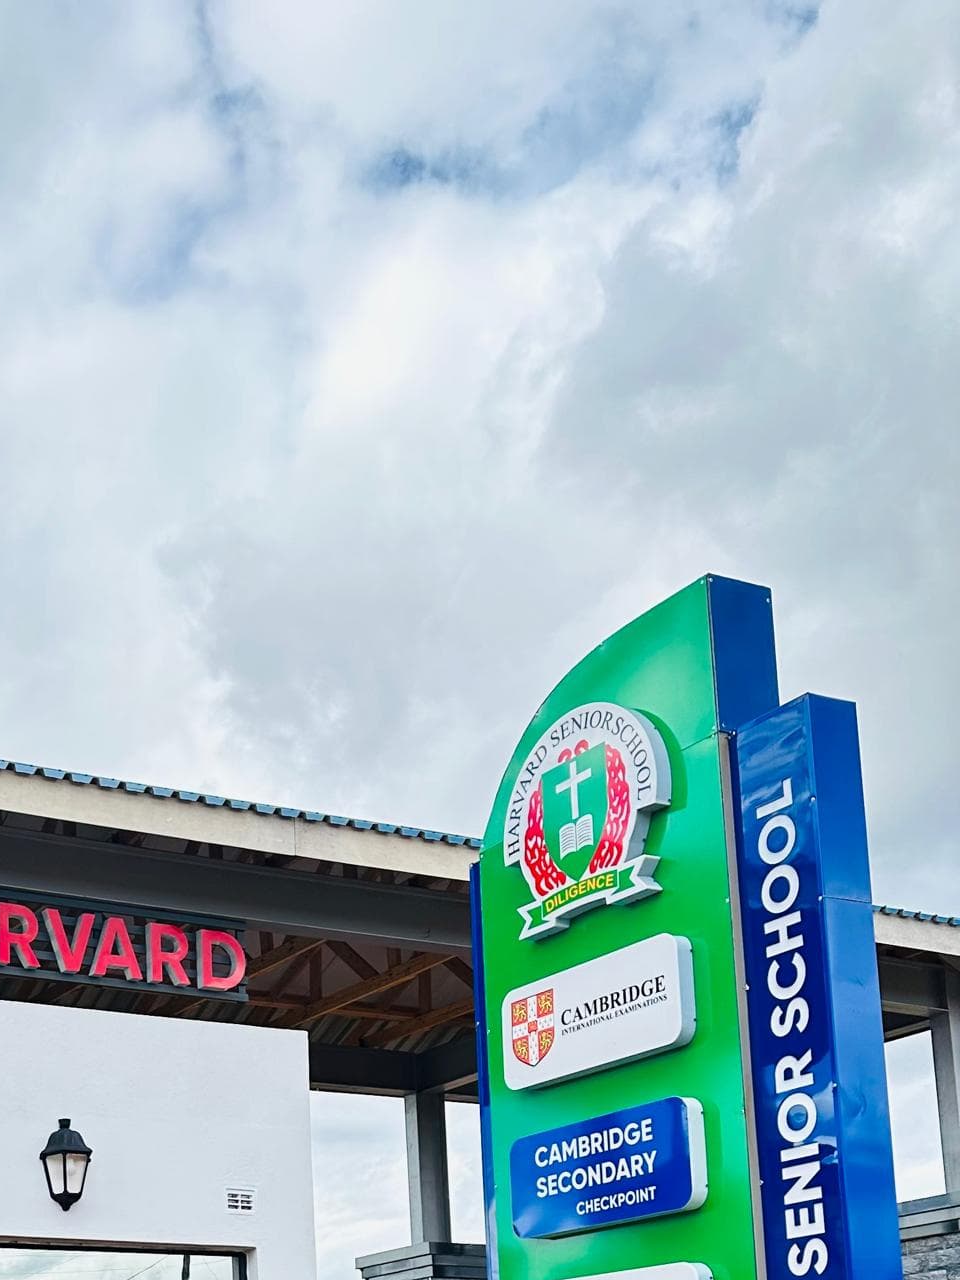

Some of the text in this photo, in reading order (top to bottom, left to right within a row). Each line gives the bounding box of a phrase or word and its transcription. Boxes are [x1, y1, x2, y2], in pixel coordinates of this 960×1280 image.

[508, 745, 548, 857] HARVARD
[545, 874, 614, 913] DILIGENCE
[755, 777, 810, 1038] SCHOOL
[560, 974, 666, 1026] CAMBRIDGE
[561, 994, 668, 1036] INTERNATIONAL EXAMINATIONS
[534, 1118, 653, 1168] CAMBRIDGE
[775, 1048, 829, 1277] SENIOR
[536, 1150, 657, 1198] SECONDARY
[575, 1186, 657, 1215] CHECKPOINT
